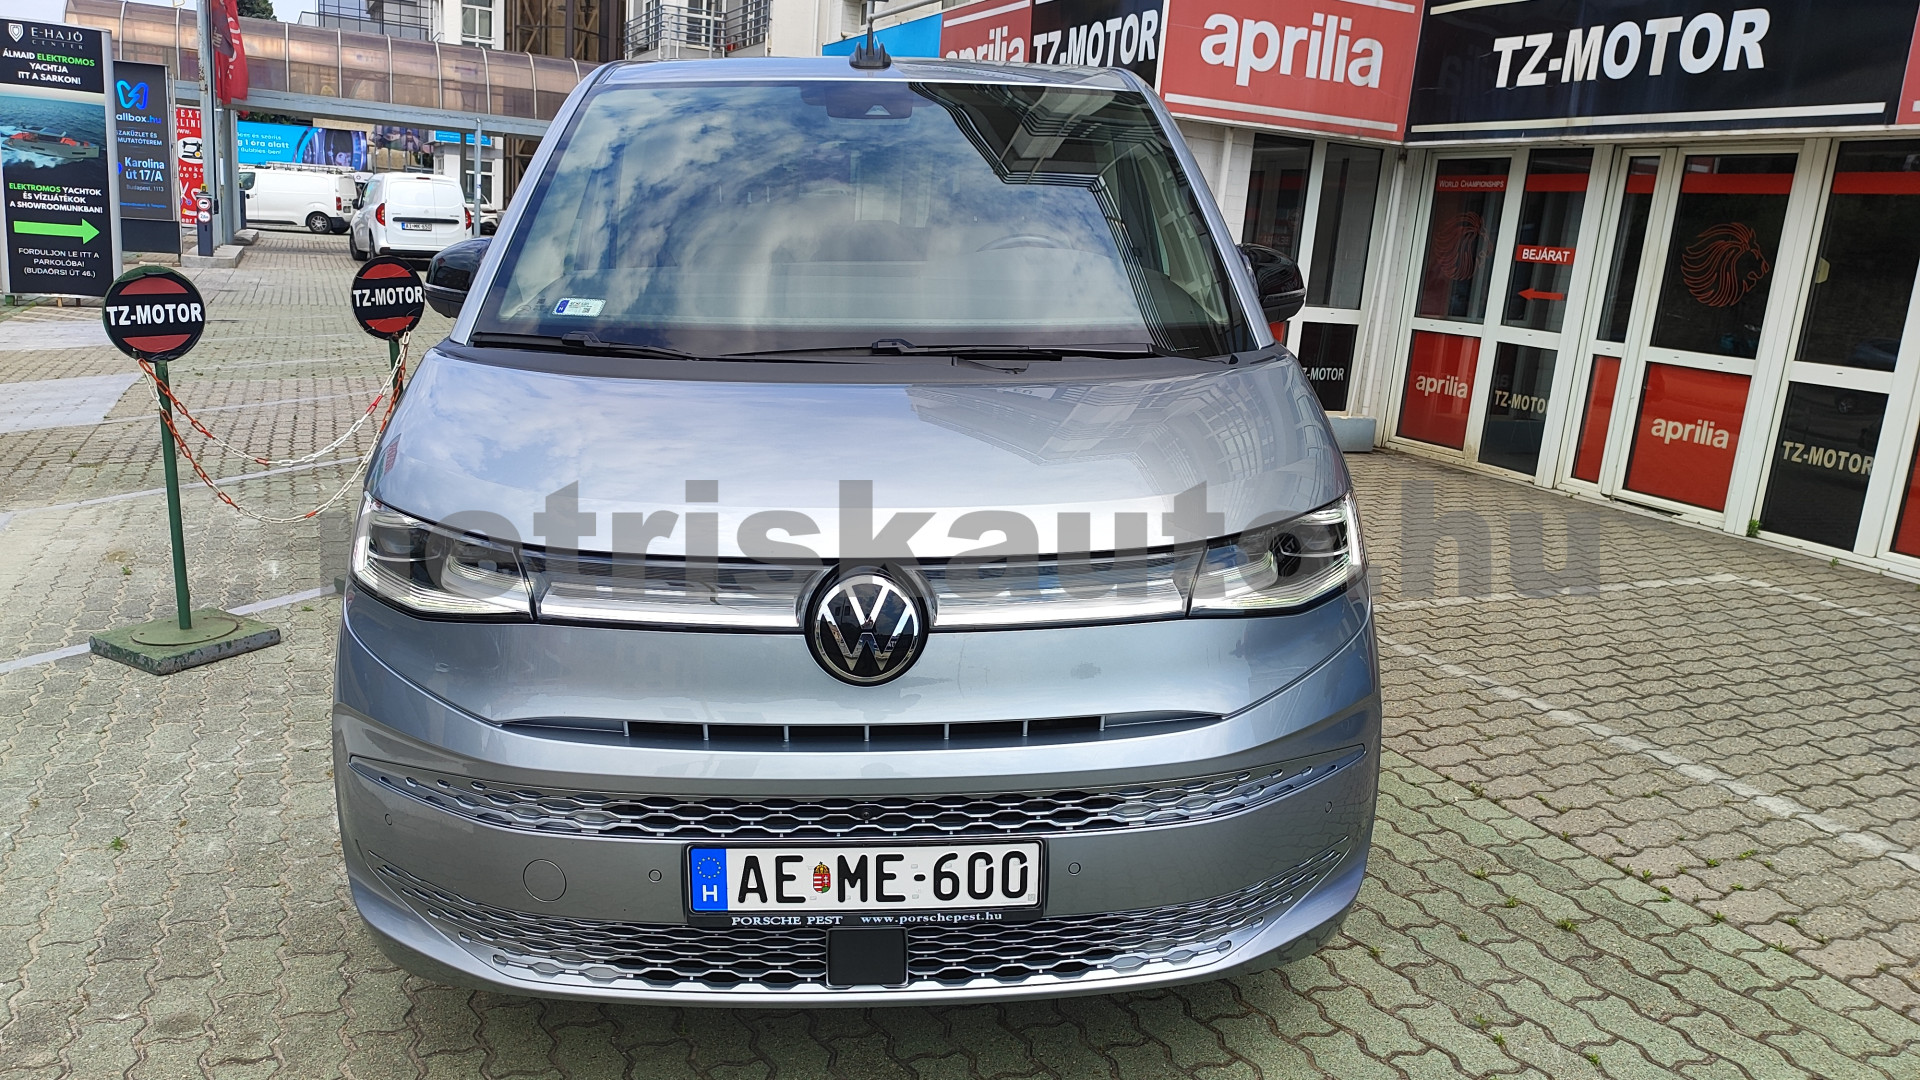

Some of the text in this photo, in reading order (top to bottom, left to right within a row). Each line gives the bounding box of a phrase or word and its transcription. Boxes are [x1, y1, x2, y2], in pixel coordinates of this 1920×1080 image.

[32, 40, 83, 50] CENTER
[1033, 9, 1159, 68] TZ-MOTOR
[1200, 12, 1384, 88] aprilia
[1493, 8, 1771, 88] TZ-MOTOR
[3, 48, 95, 67] ÁLMAID ELEKTROMOS
[29, 62, 69, 73] YACHTJA
[17, 71, 30, 79] ITT
[40, 73, 82, 85] SARKON!
[116, 113, 162, 124] allbox.hu
[117, 137, 163, 146] MUTATÓTEREM
[124, 157, 165, 170] Karolina
[126, 169, 164, 182] út 17/A
[9, 182, 102, 196] ELEKTROMOS YACHTOK
[22, 191, 32, 200] ÉS
[18, 248, 66, 257] FORDULJON
[1521, 247, 1570, 263] BEJÁRAT
[353, 286, 423, 307] TZ-MOTOR
[106, 303, 203, 326] TZ-MOTOR
[1415, 375, 1468, 399] aprilia
[1495, 389, 1549, 414] TZ-MOTO
[1651, 418, 1729, 449] aprilia
[1782, 441, 1874, 476] TZ-MOTOR
[702, 884, 718, 902] H
[731, 911, 1003, 926] PORSCHE PEST www.porschepest.hu
